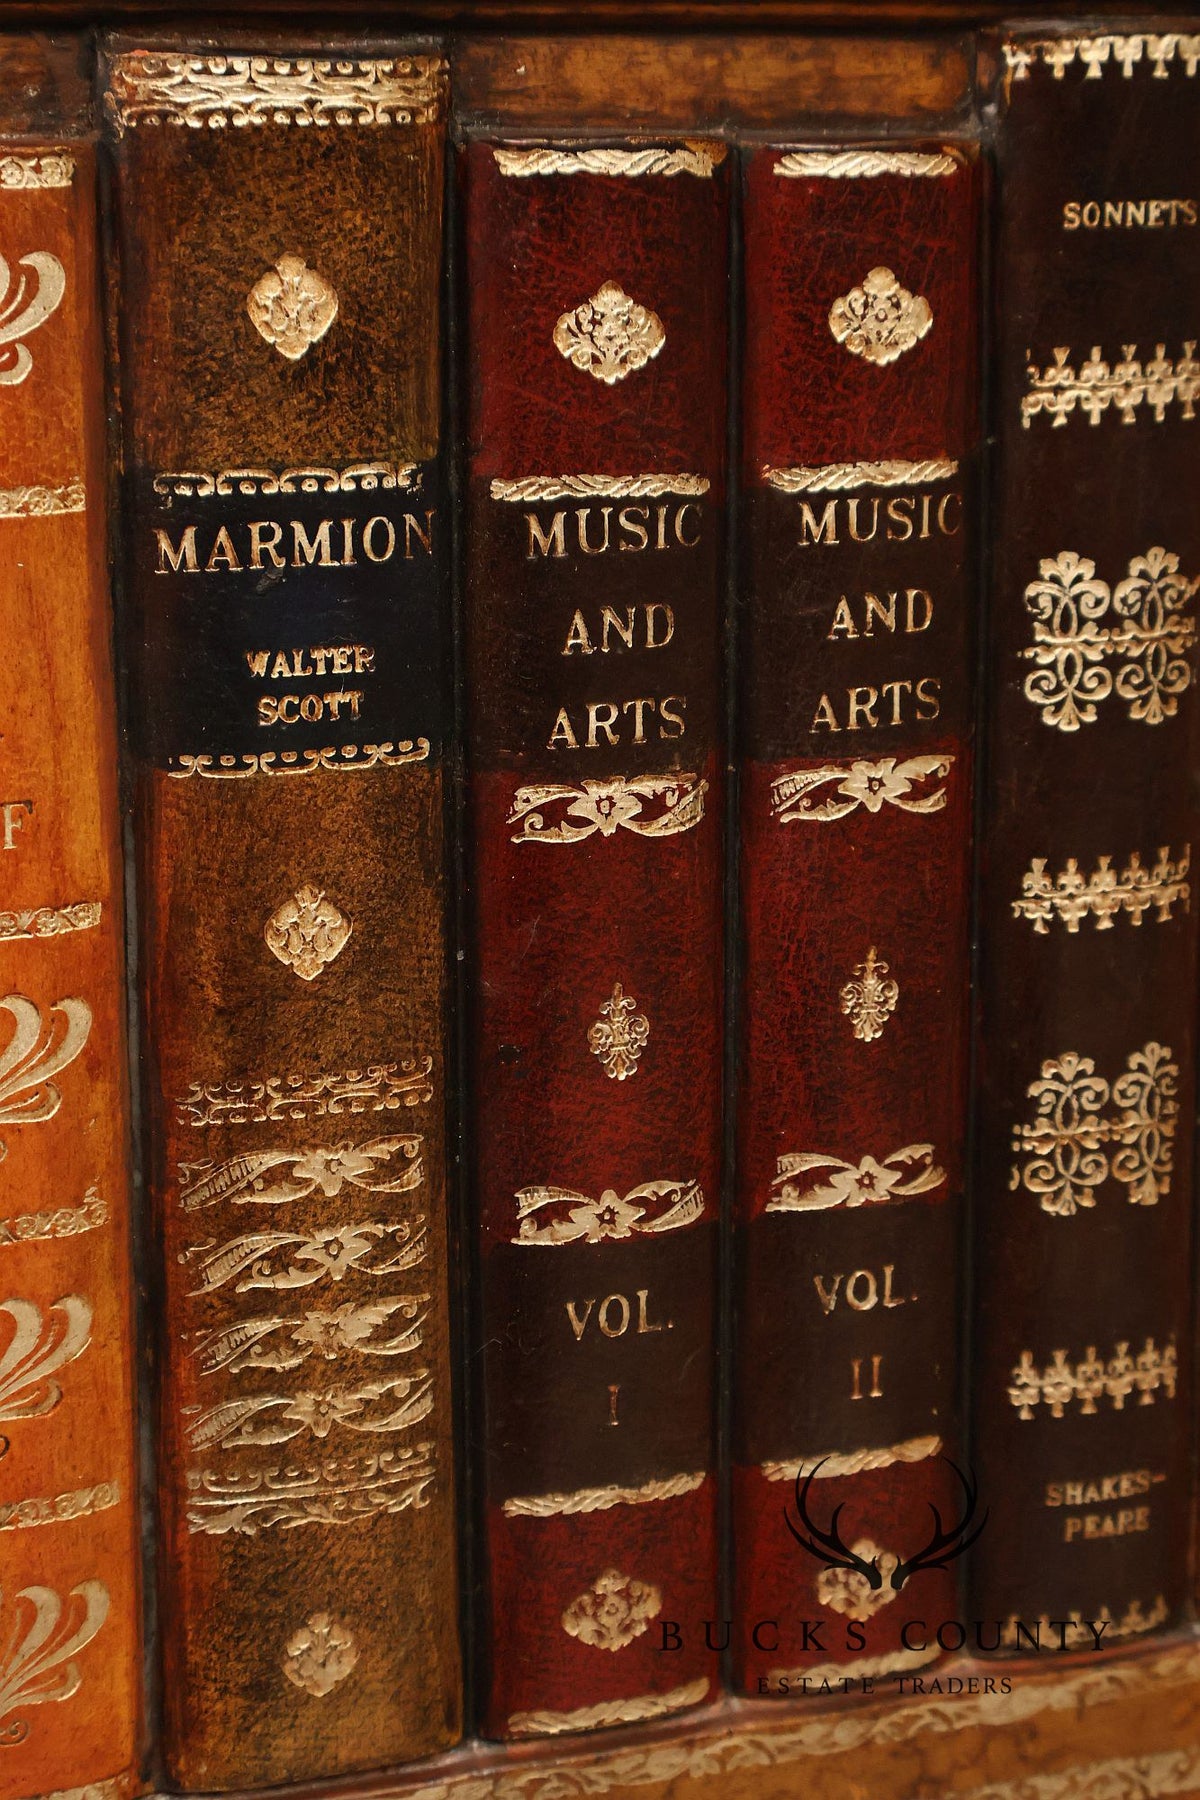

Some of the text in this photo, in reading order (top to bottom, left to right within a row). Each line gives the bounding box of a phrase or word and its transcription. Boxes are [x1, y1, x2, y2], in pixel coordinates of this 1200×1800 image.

[1063, 199, 1197, 230] SONNETS
[153, 508, 437, 574] MARMION
[523, 504, 702, 560] MUSIC
[798, 494, 963, 546] MUSIC
[561, 602, 675, 655] AND
[827, 588, 934, 640] AND
[247, 645, 376, 679] WALTER
[258, 690, 365, 727] SCOTT
[546, 695, 688, 750] ARTS
[810, 678, 942, 734] ARTS
[565, 1289, 674, 1342] VOL.
[813, 1264, 919, 1315] VOL.
[850, 1354, 883, 1400] II
[607, 1384, 622, 1426] I
[1045, 1470, 1167, 1507] SHAKES-
